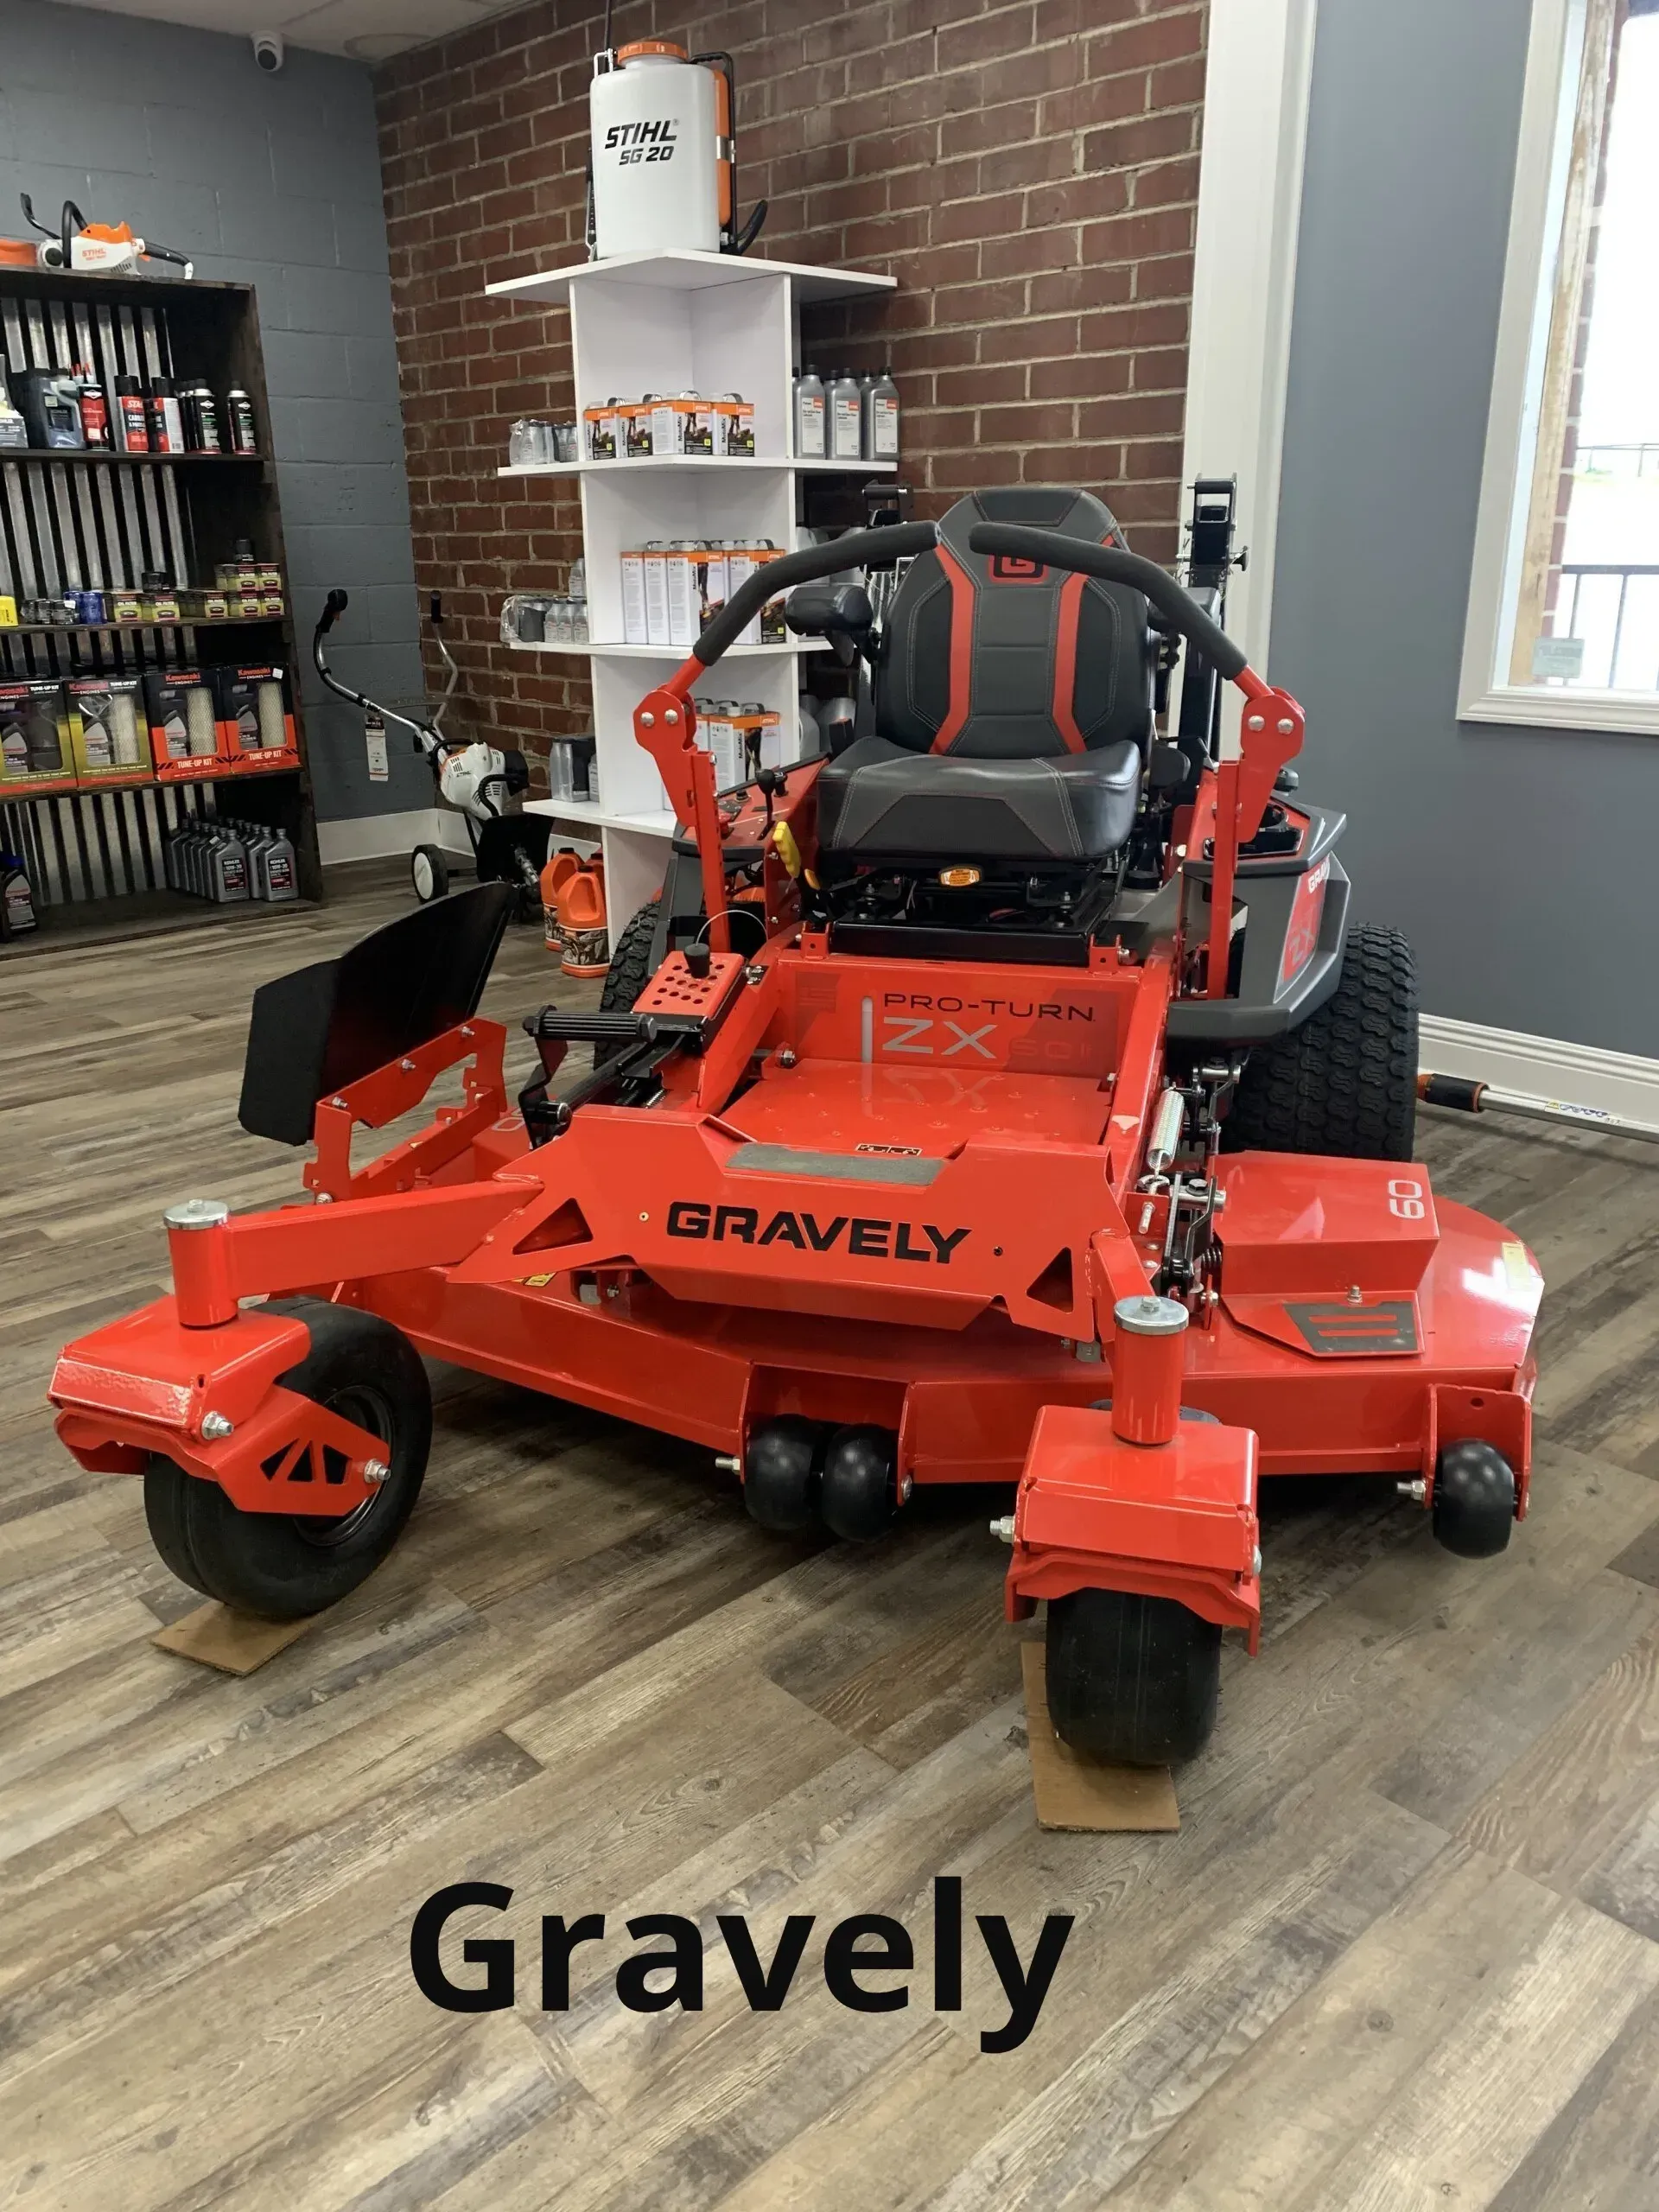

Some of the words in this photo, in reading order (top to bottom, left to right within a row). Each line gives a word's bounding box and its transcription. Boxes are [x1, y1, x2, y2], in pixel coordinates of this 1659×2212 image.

[605, 119, 677, 149] STIHL
[619, 148, 644, 166] SG
[645, 145, 675, 162] 20
[165, 672, 201, 682] Kawasaki
[176, 759, 203, 769] TUNE-UP
[884, 993, 1095, 1022] PRO-TURN
[881, 1015, 998, 1059] ZX
[666, 1200, 973, 1264] GRAVELY
